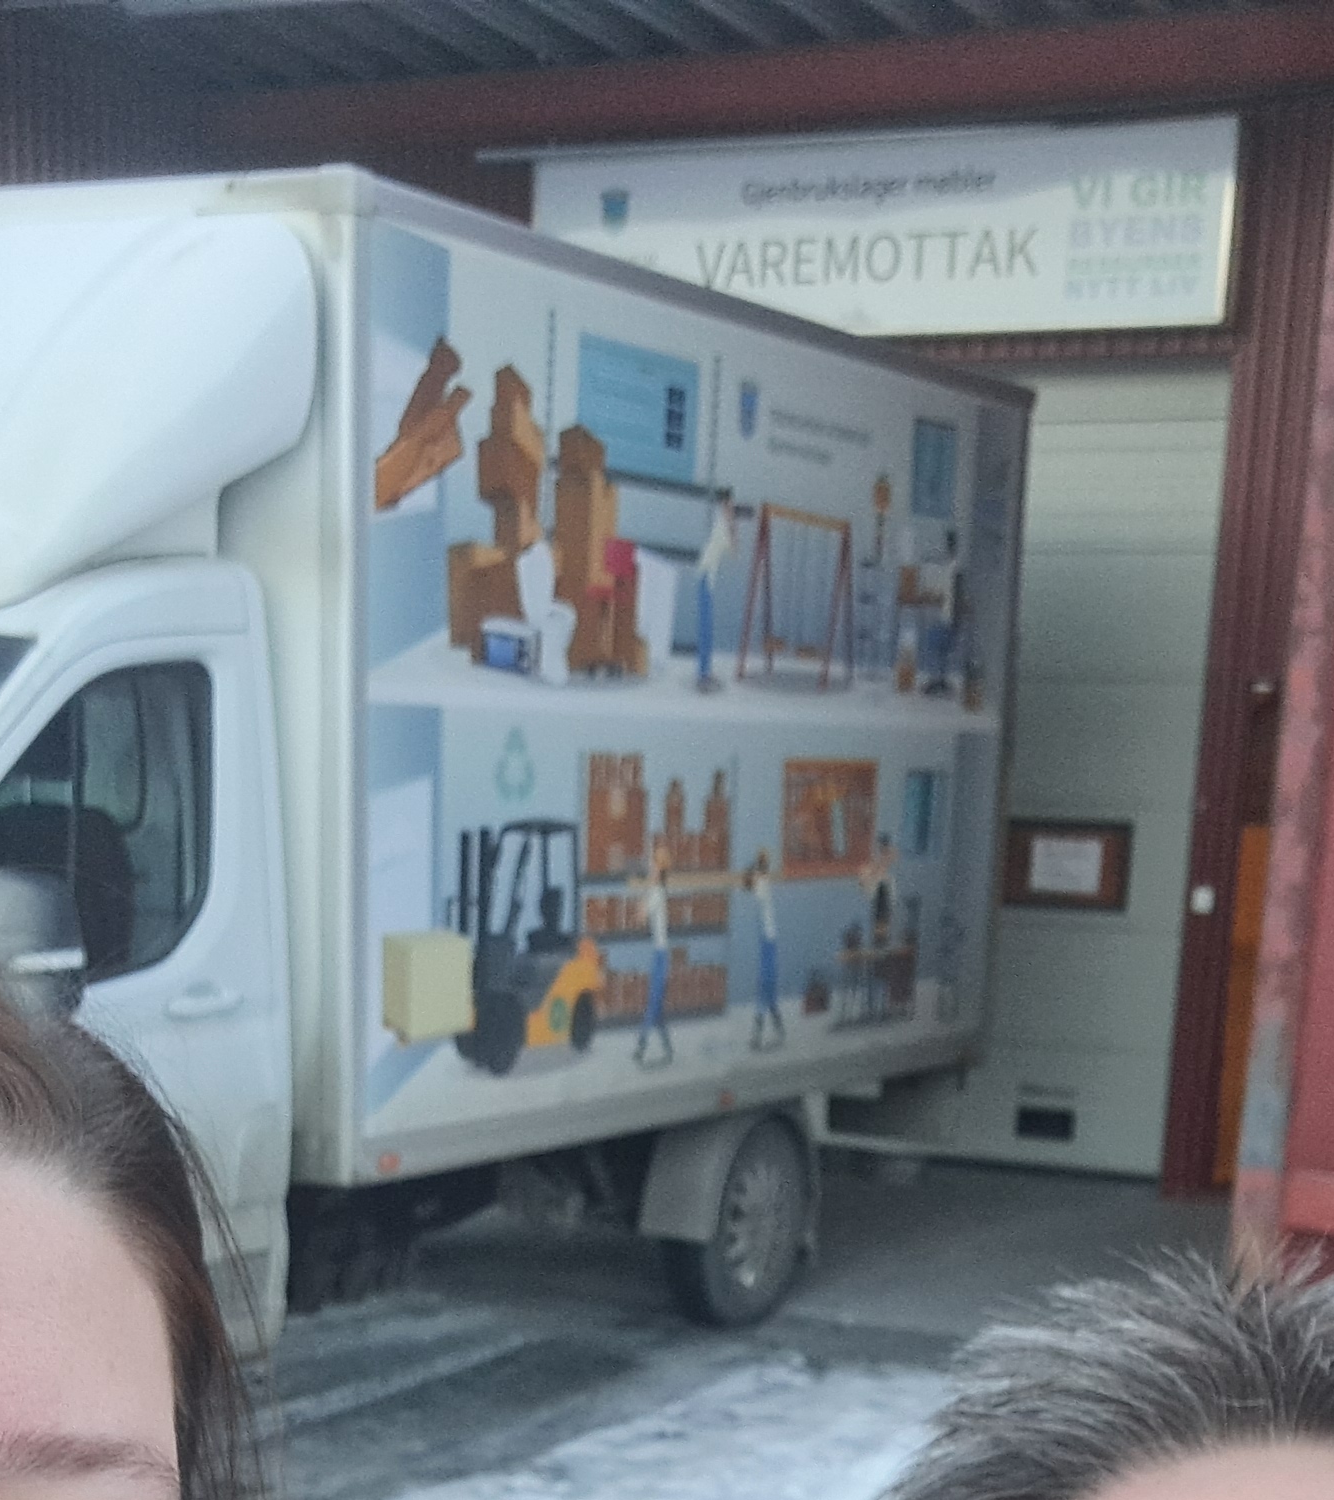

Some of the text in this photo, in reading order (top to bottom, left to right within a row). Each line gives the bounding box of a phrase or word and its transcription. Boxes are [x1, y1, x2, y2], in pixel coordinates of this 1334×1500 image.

[1069, 167, 1208, 210] VI GIR
[695, 228, 1038, 291] VAREMOTTAK
